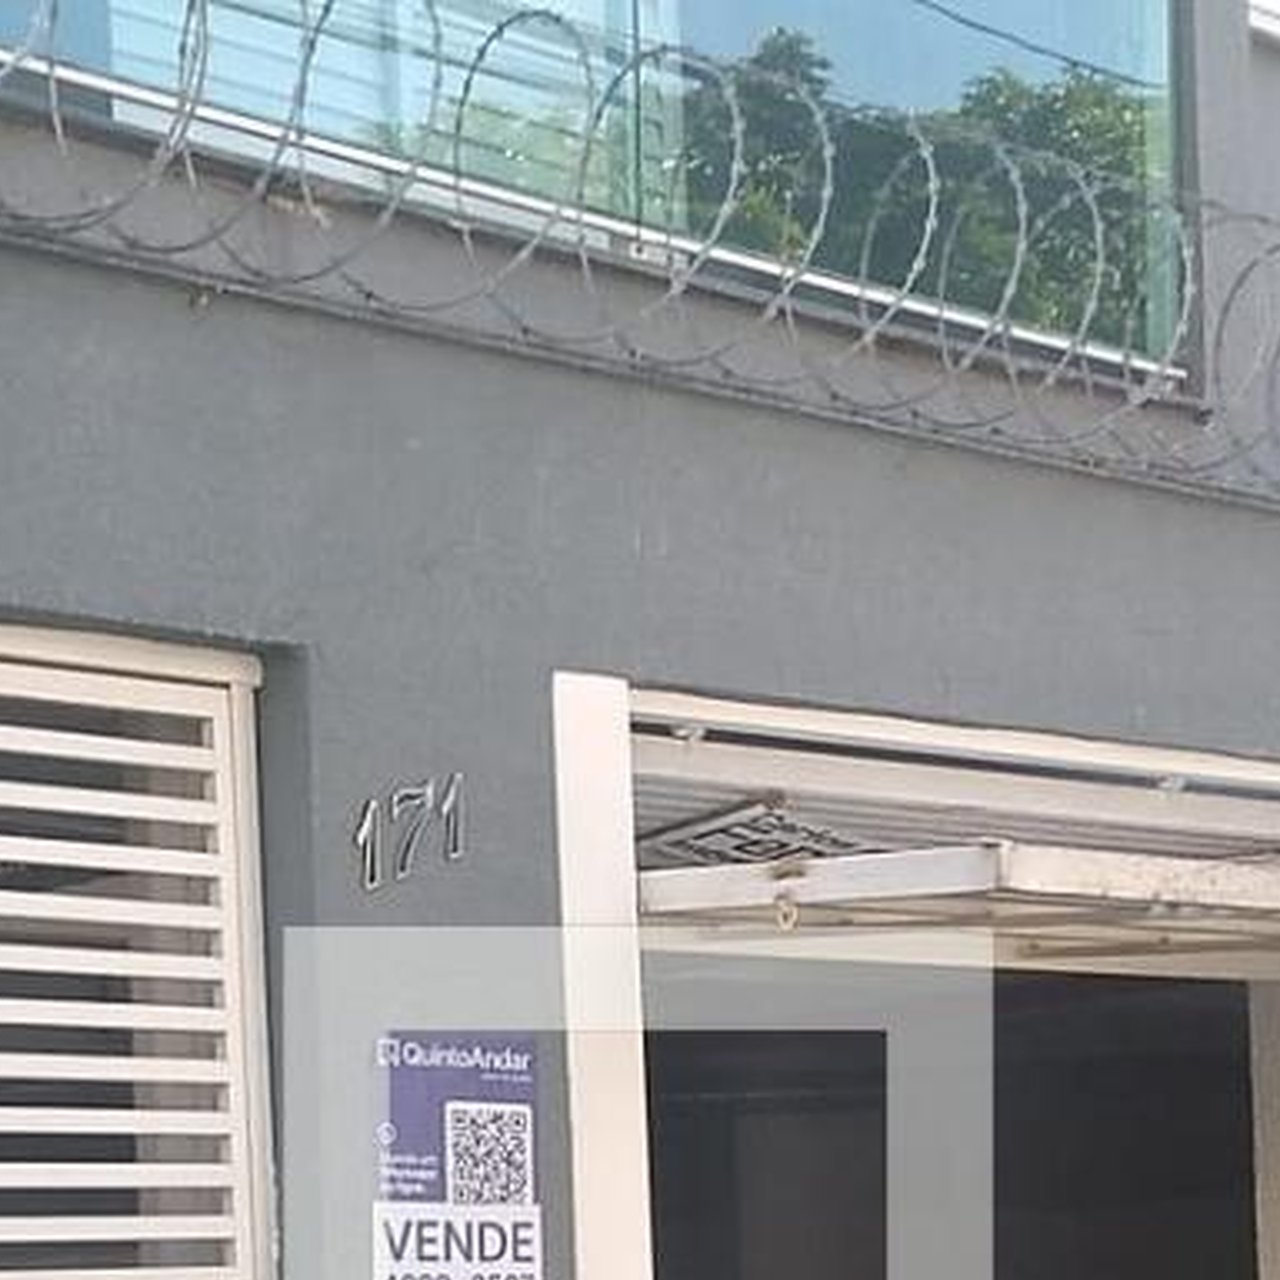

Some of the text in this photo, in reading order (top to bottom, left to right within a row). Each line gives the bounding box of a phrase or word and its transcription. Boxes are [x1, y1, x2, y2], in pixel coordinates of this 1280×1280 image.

[353, 772, 464, 889] 171
[402, 1041, 532, 1073] QuintoAndar
[382, 1220, 535, 1262] VENDE
